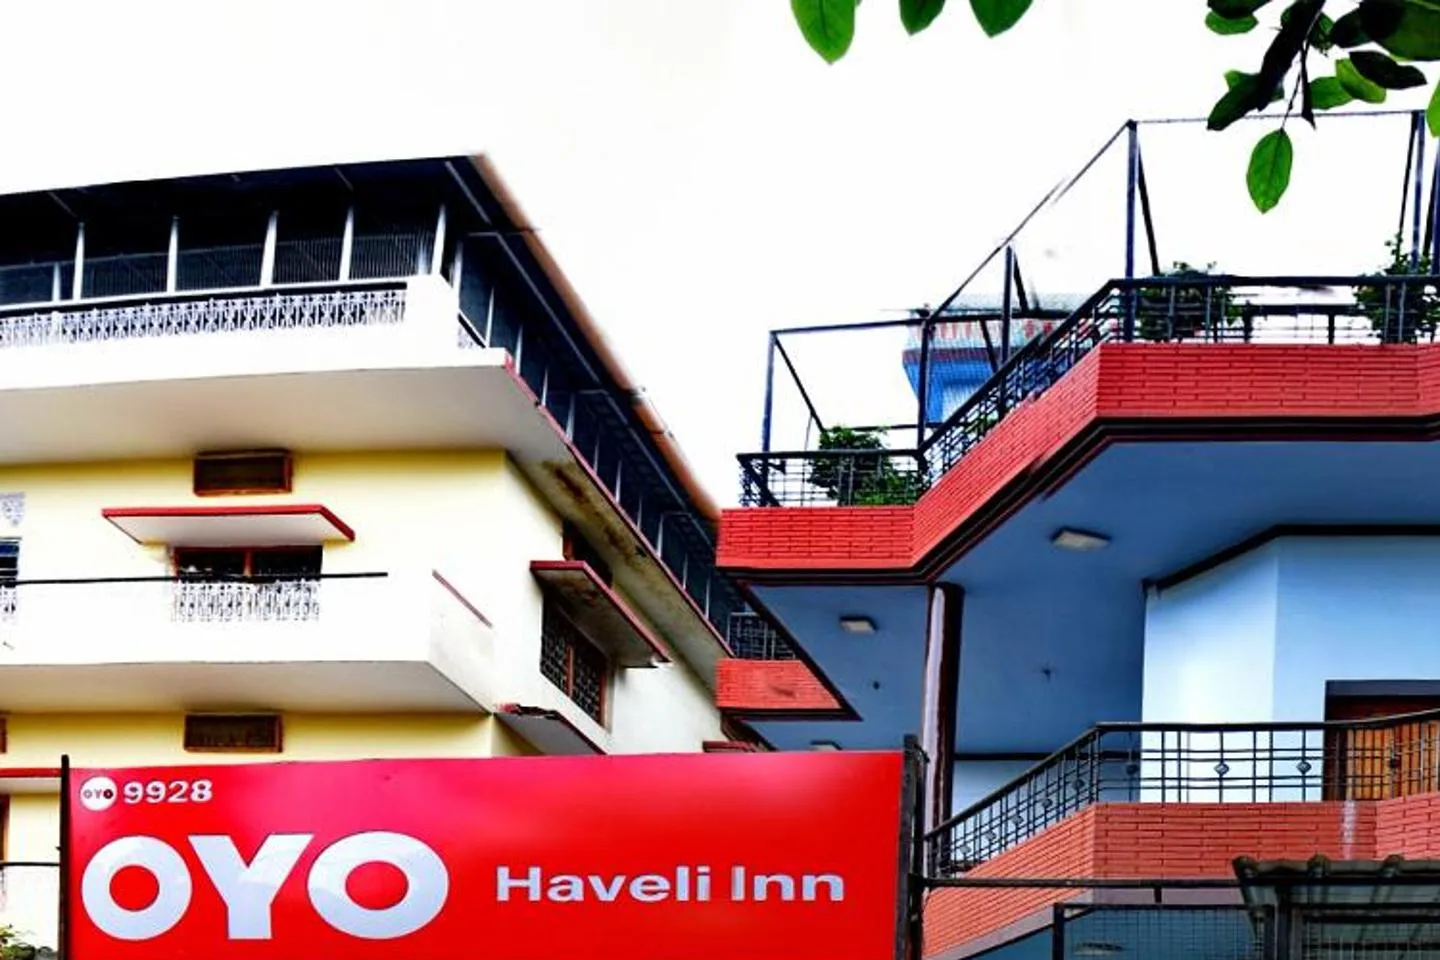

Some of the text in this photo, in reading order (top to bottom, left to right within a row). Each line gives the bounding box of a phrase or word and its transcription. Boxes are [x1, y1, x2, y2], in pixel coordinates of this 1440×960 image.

[84, 779, 213, 803] OYO 9928
[82, 831, 449, 941] OYO
[496, 865, 845, 902] Haveli Inn
